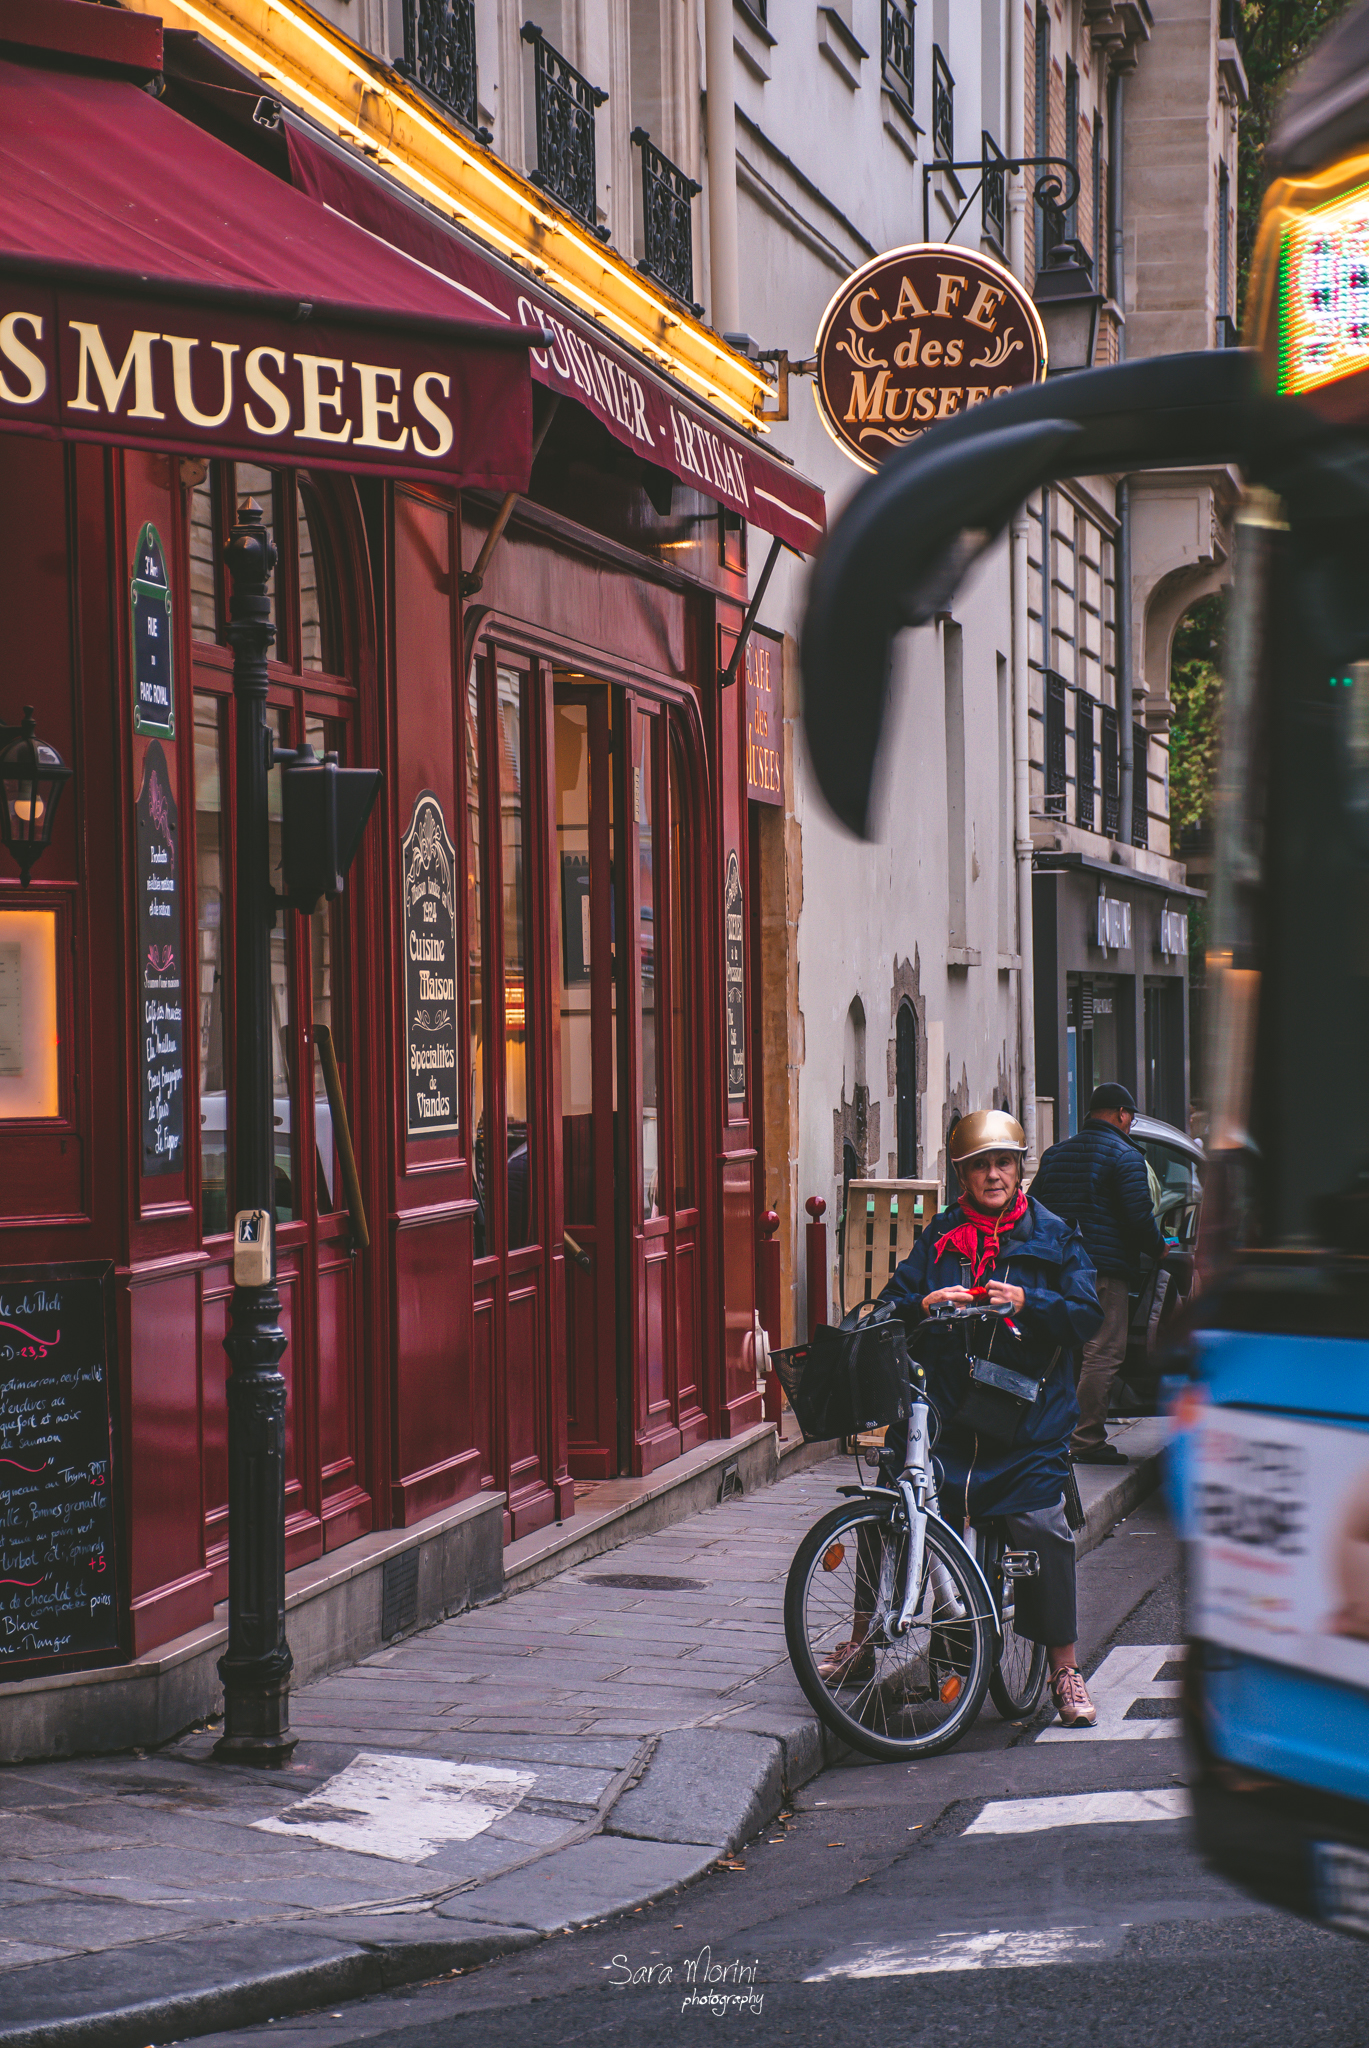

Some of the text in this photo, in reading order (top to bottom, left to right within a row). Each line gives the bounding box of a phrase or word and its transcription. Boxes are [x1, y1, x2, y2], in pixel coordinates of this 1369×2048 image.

[849, 273, 1007, 332] CAFE
[893, 328, 964, 368] des
[67, 320, 454, 458] MUSEES
[517, 296, 749, 508] CUISINIER ARTISAN
[843, 370, 1013, 423] MUSEE
[147, 616, 158, 637] RUE
[140, 681, 169, 706] PARC ROYAL
[754, 696, 768, 737] des
[422, 901, 438, 922] 1924
[409, 930, 445, 961] Cuisine
[419, 970, 454, 1001] Maison
[410, 1043, 455, 1077] Spécialités
[429, 1075, 437, 1090] de
[417, 1091, 450, 1119] Viandes
[15, 1295, 36, 1314] du
[51, 1397, 65, 1407] au
[40, 1413, 52, 1425] et
[0, 1438, 13, 1449] de
[45, 1481, 60, 1490] au
[87, 1460, 107, 1476] PDT
[36, 1534, 48, 1542] au
[51, 1526, 75, 1547] poivre
[77, 1518, 95, 1534] vert
[0, 1550, 39, 1571] turbot
[88, 1555, 107, 1573] +5
[24, 1582, 72, 1608] chocolat
[74, 1579, 87, 1598] et
[90, 1593, 111, 1618] poires
[2, 1614, 40, 1635] Blanc
